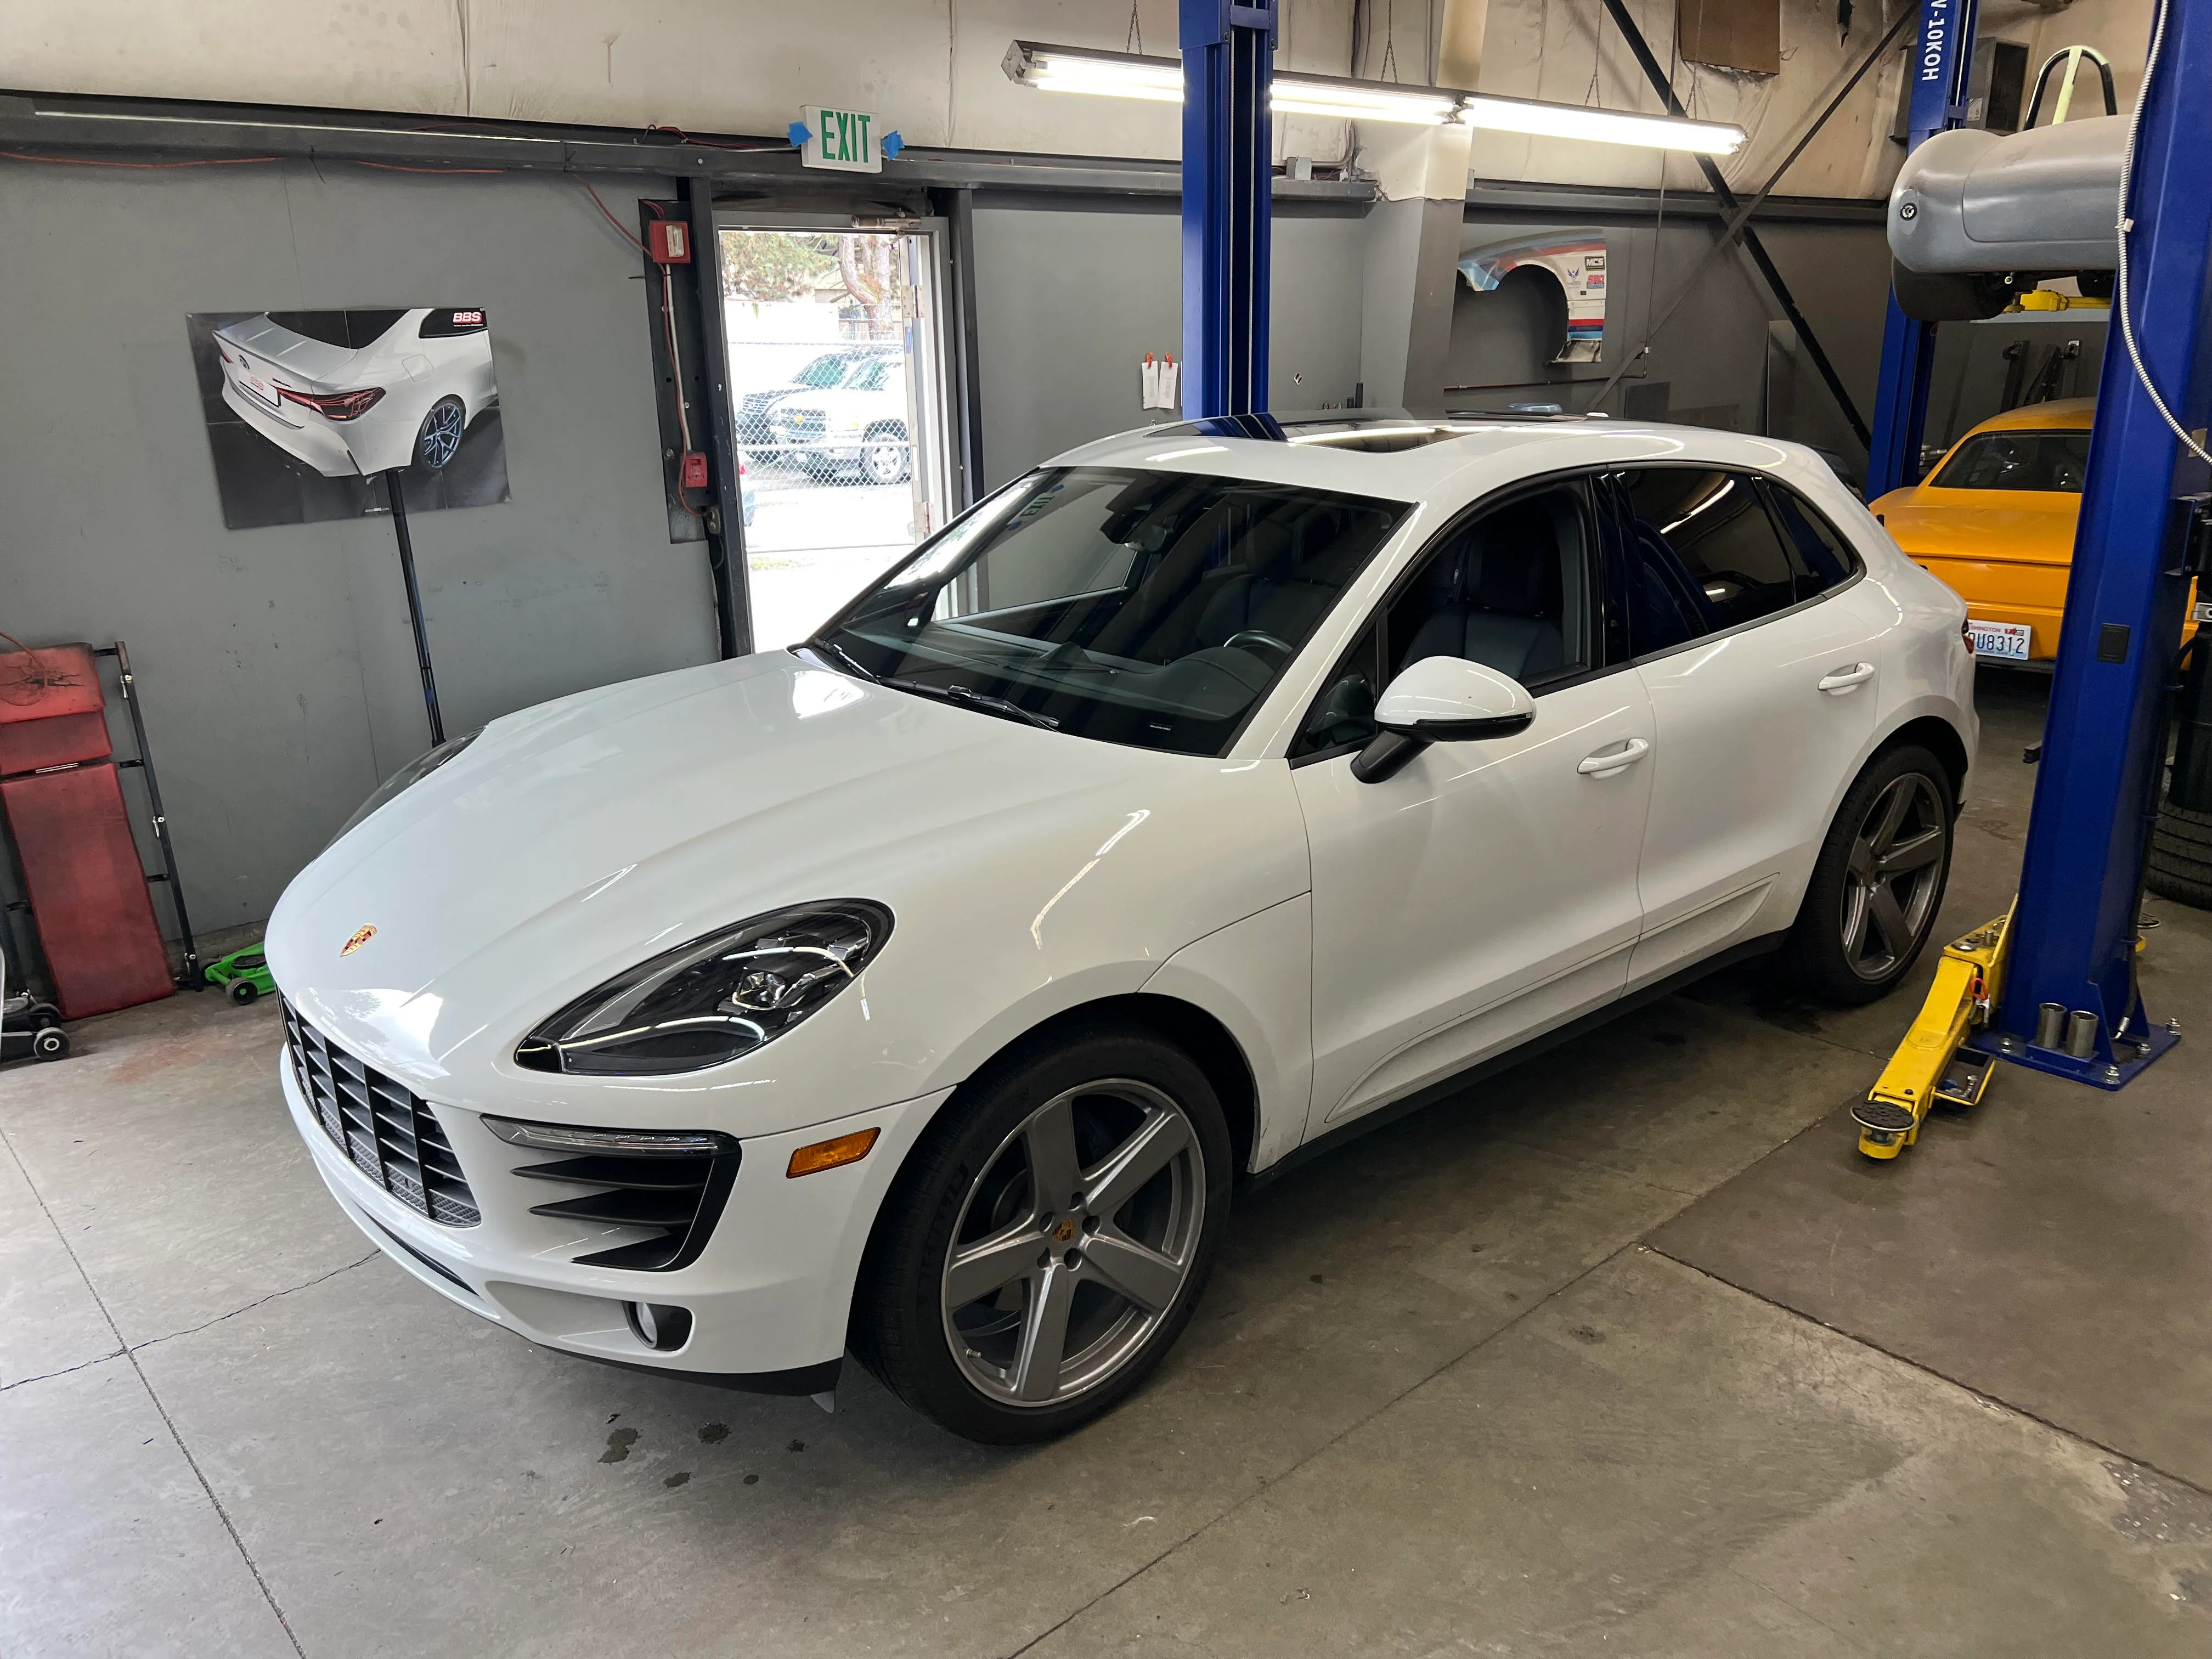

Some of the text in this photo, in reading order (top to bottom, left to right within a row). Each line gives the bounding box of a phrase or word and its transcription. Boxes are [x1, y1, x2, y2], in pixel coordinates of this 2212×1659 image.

[820, 110, 871, 163] EXIT
[1586, 258, 1604, 267] MCS
[453, 311, 482, 324] BBS
